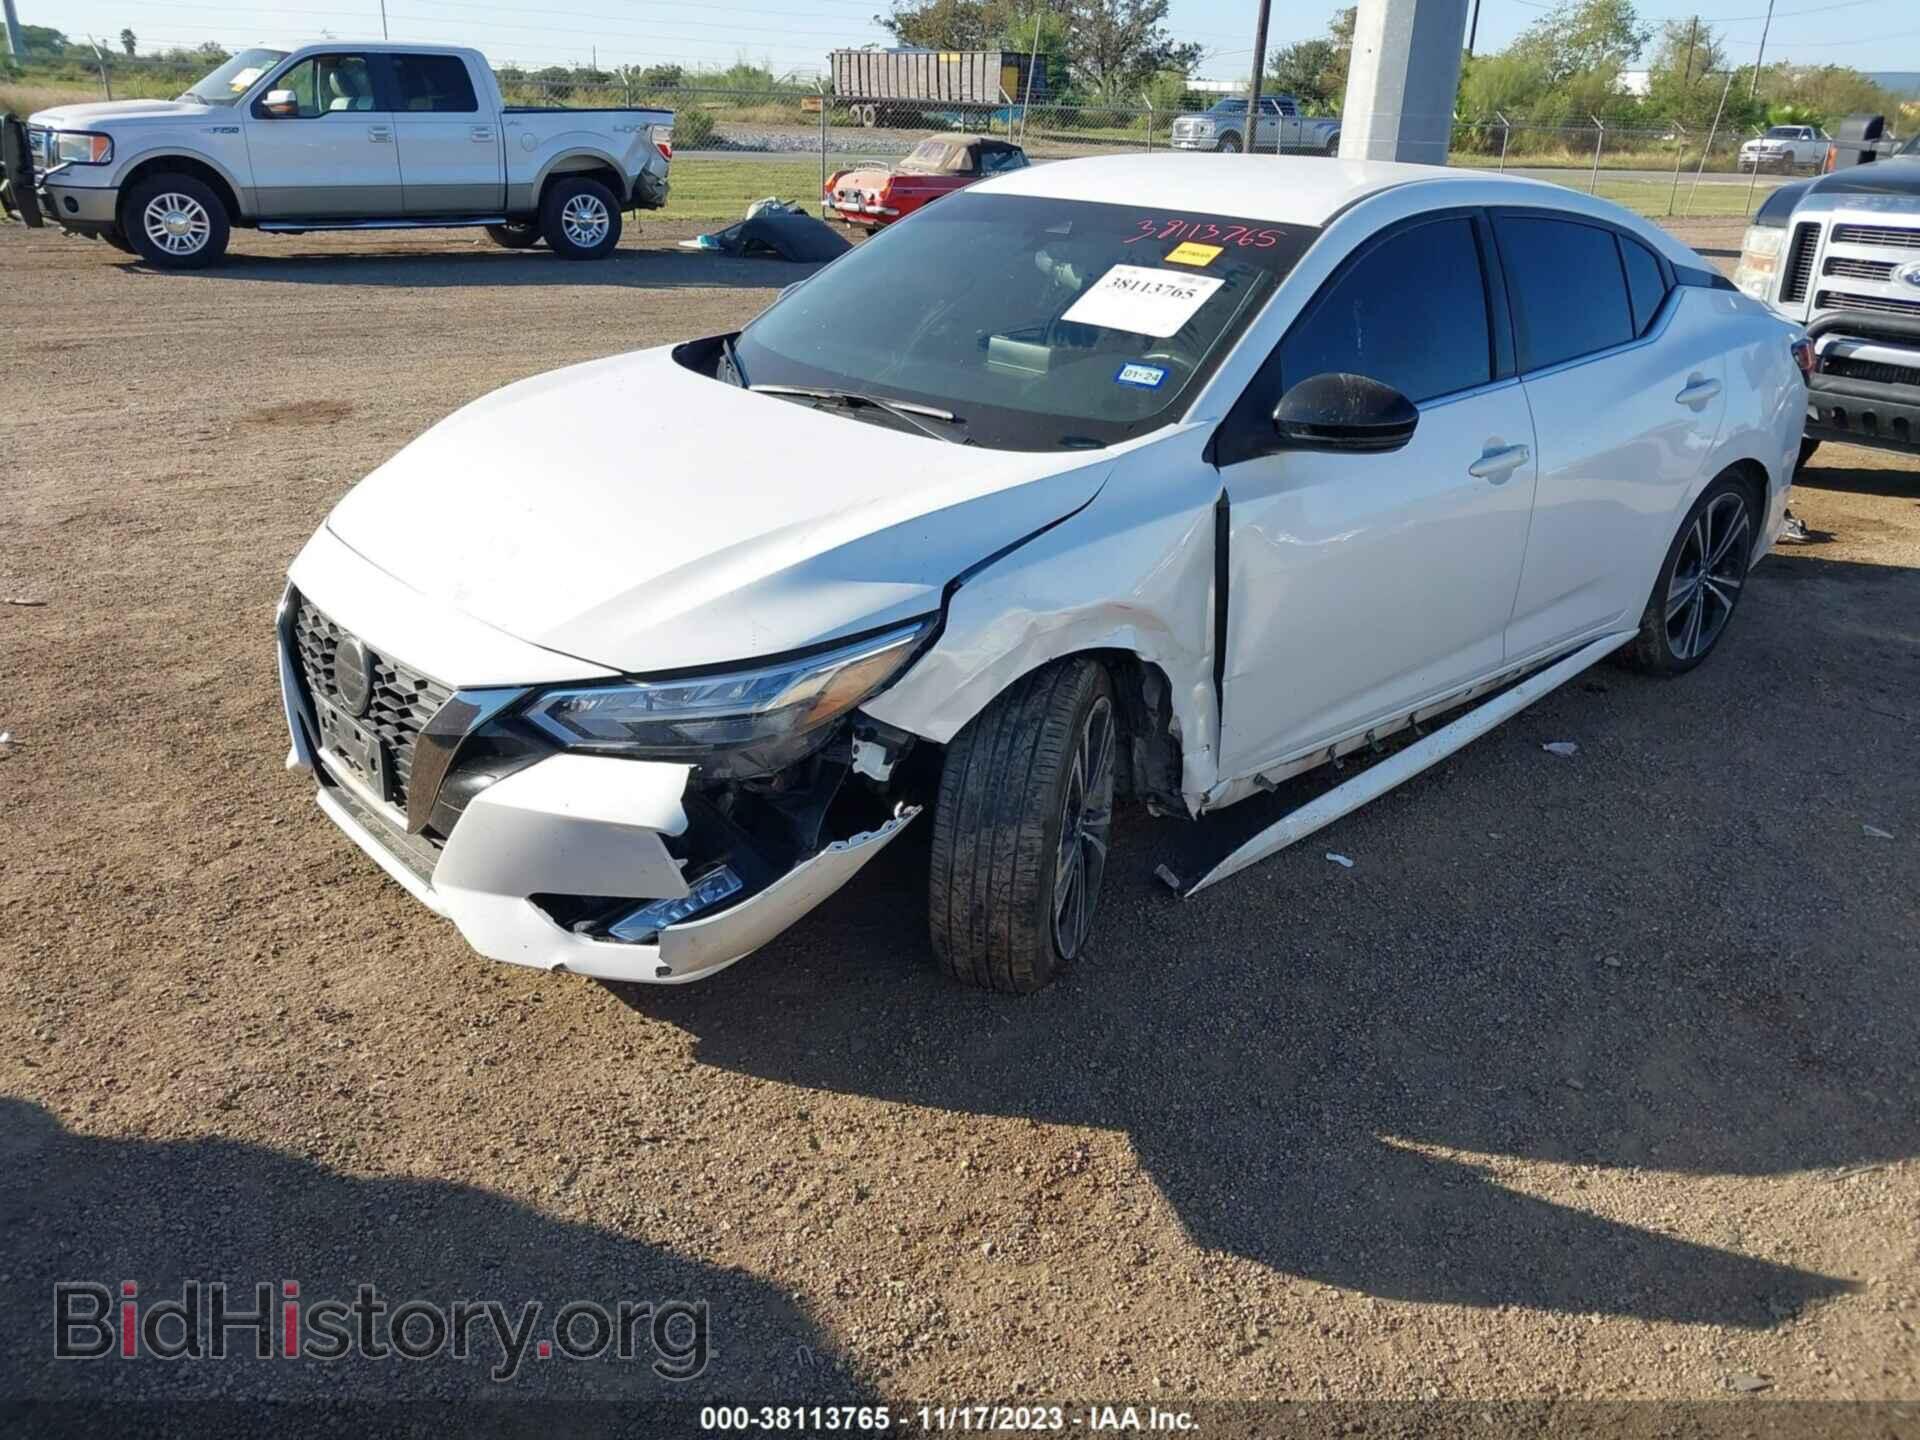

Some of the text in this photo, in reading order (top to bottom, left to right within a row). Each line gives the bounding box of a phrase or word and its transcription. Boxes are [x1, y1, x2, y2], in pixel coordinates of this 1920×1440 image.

[1123, 219, 1288, 247] 38113765
[1106, 276, 1199, 301] 38113765
[1124, 369, 1161, 382] 01-24
